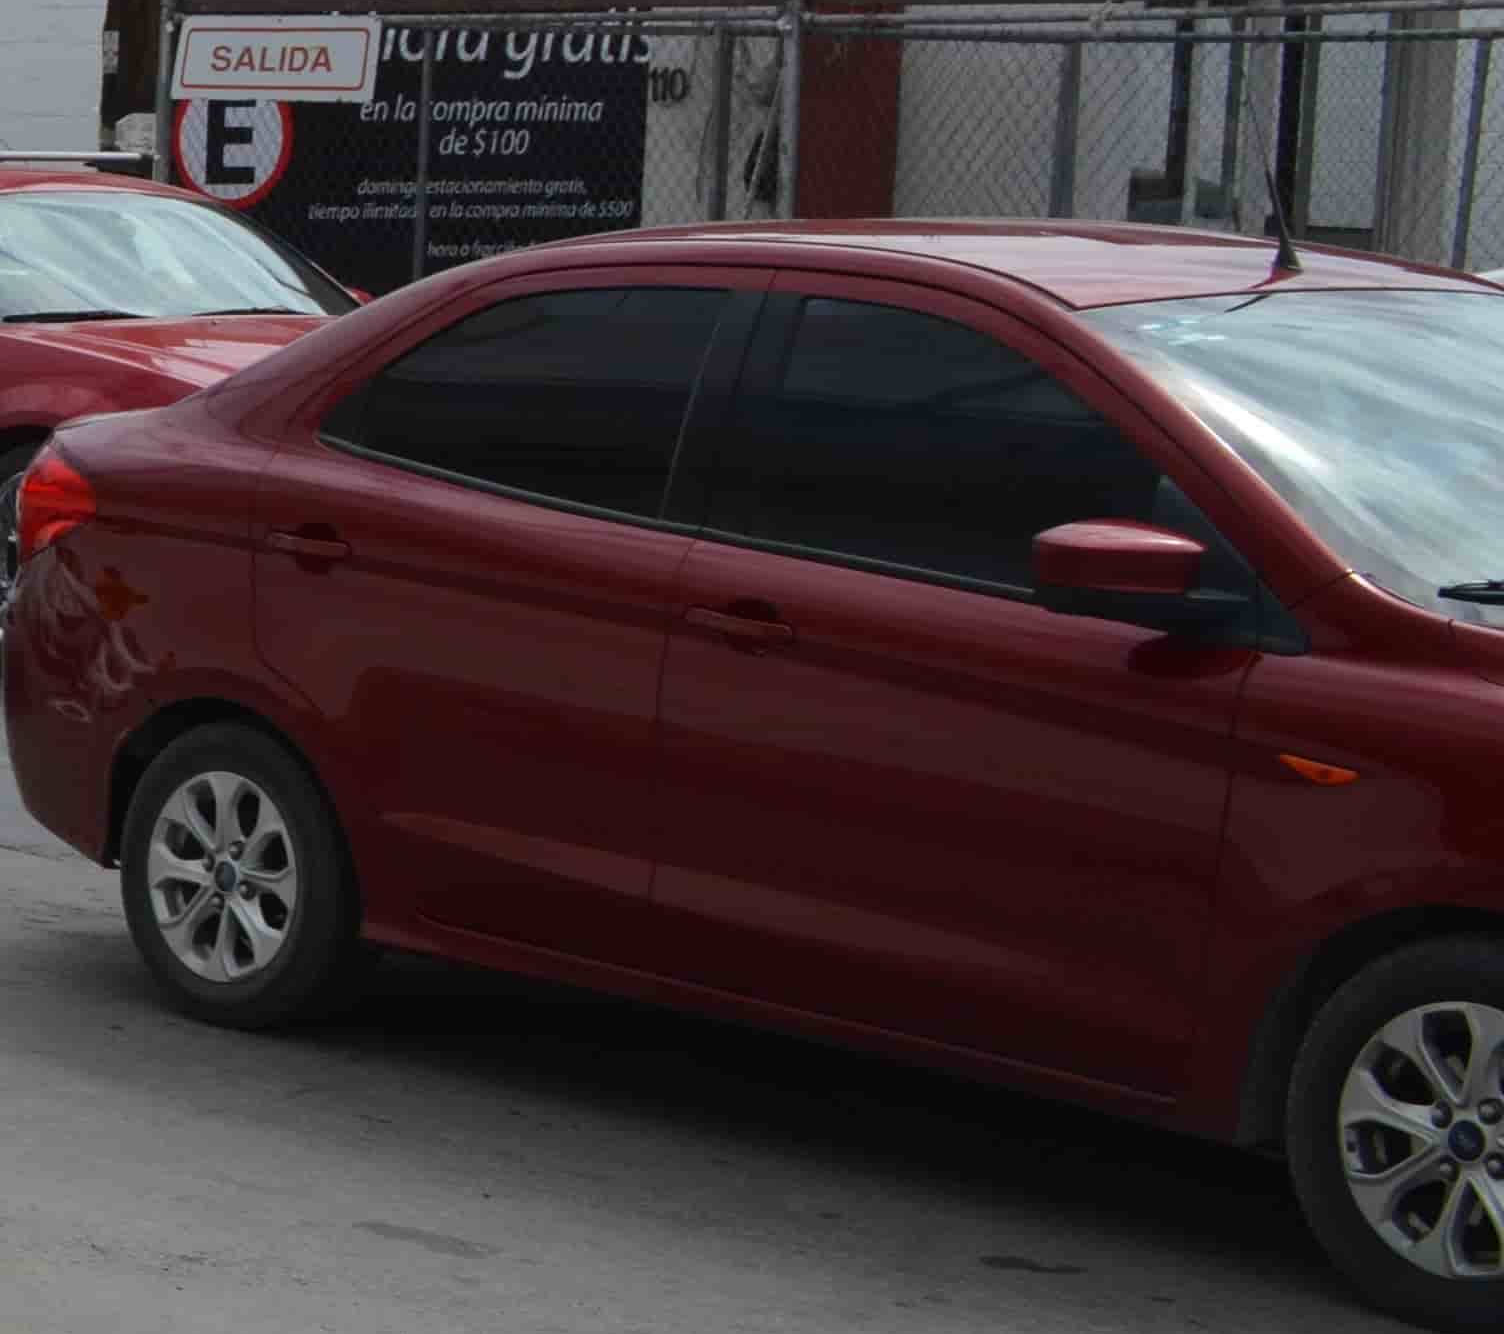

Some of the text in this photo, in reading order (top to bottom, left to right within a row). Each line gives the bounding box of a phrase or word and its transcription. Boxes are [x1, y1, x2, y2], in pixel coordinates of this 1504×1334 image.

[210, 45, 333, 73] SALIDA
[360, 99, 388, 122] en
[393, 93, 416, 122] la
[429, 99, 511, 129] ompra
[205, 99, 257, 185] E
[439, 127, 531, 156] de $100
[357, 178, 417, 199] doming
